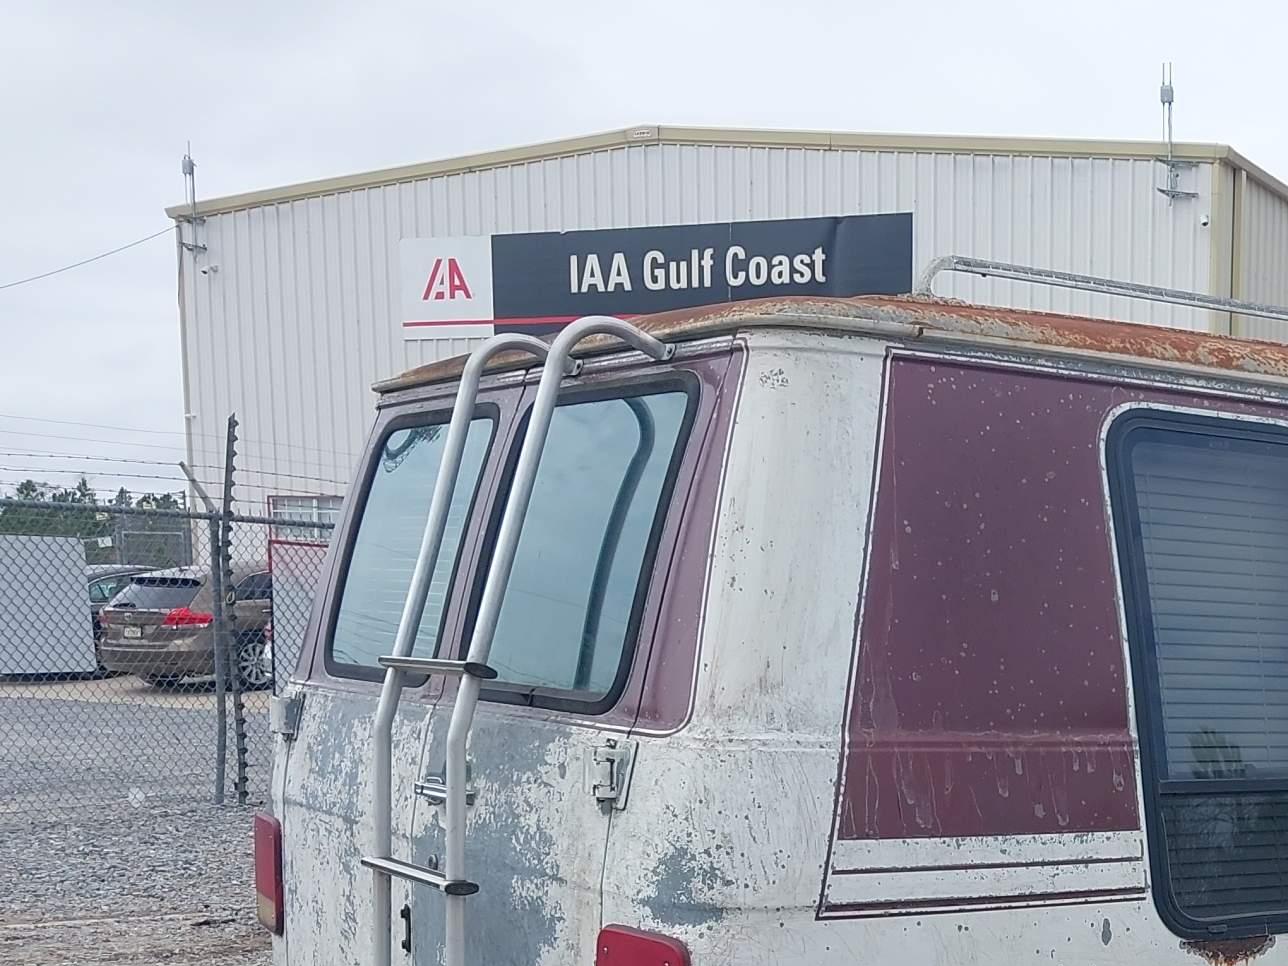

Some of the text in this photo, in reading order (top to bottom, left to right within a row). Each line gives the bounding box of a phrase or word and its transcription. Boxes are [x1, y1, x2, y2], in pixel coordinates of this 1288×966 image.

[570, 245, 826, 293] IAA Gulf Coast
